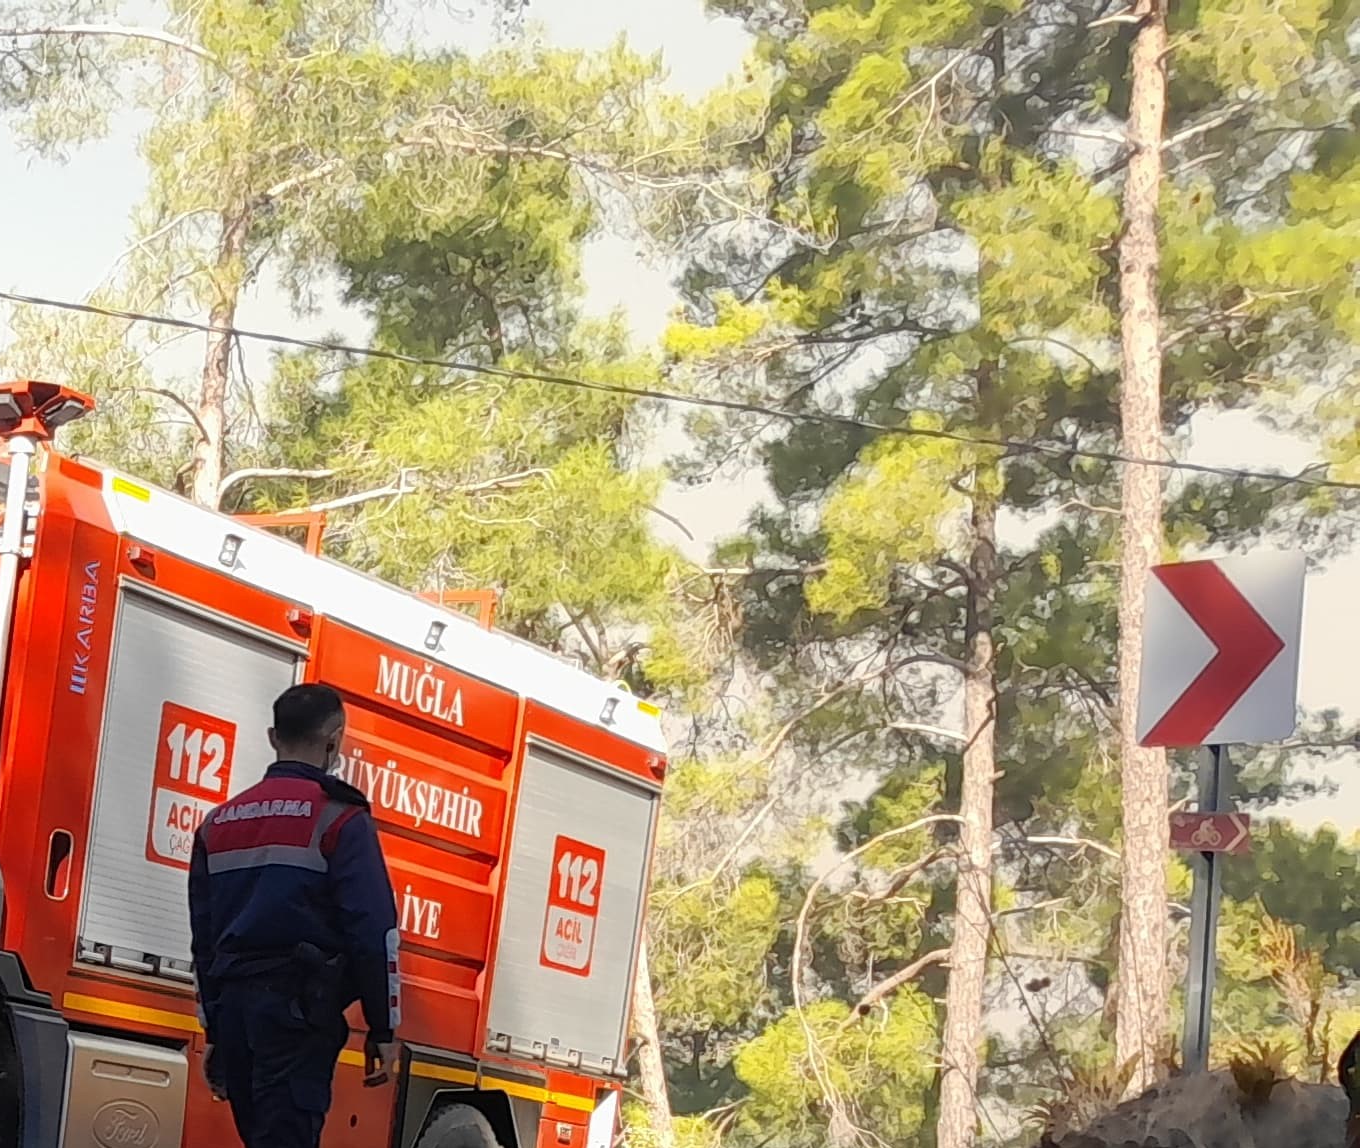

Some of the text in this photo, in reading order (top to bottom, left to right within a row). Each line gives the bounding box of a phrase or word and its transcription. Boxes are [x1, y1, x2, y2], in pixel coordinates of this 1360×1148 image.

[374, 654, 465, 727] MUĞLA
[167, 722, 226, 793] 112
[214, 799, 312, 824] JANDARMA
[557, 851, 599, 907] 112
[555, 916, 583, 944] ACİL
[103, 1108, 149, 1146] Ford
